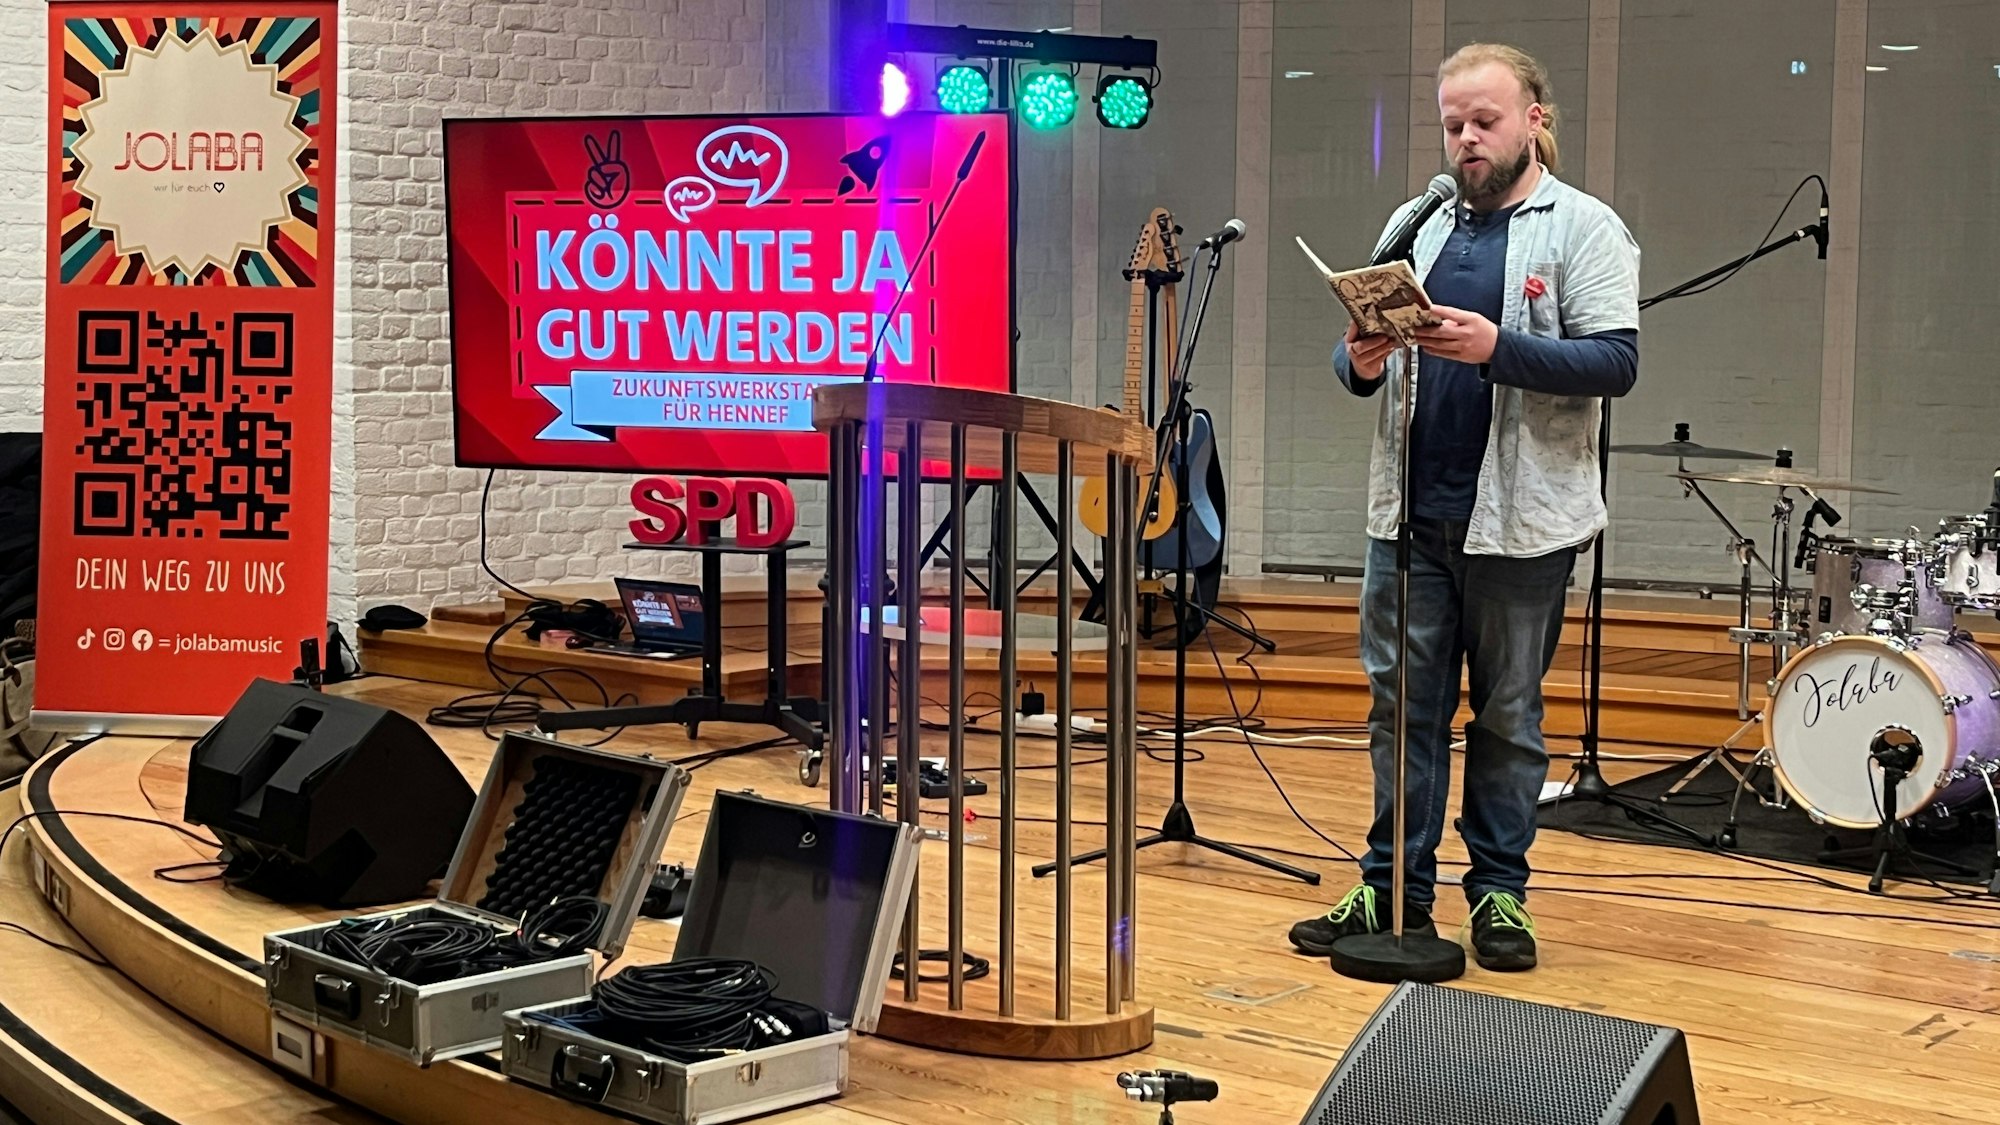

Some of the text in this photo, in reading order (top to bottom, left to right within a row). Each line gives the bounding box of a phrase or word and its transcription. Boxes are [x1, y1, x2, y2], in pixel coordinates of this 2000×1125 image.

[114, 131, 264, 172] JOLABA
[153, 184, 168, 192] wir
[187, 183, 211, 193] euch
[536, 213, 914, 293] KÖNNTE JA
[536, 308, 913, 365] GUT WERDEN
[612, 378, 816, 401] ZUKUNFTSWERKSTA
[663, 399, 789, 423] FÜR HENNEF
[628, 475, 796, 548] SPD
[75, 557, 286, 595] DEIN WEG ZU UNS
[173, 632, 283, 655] jolabamusic
[1795, 656, 1904, 728] Jolaba
